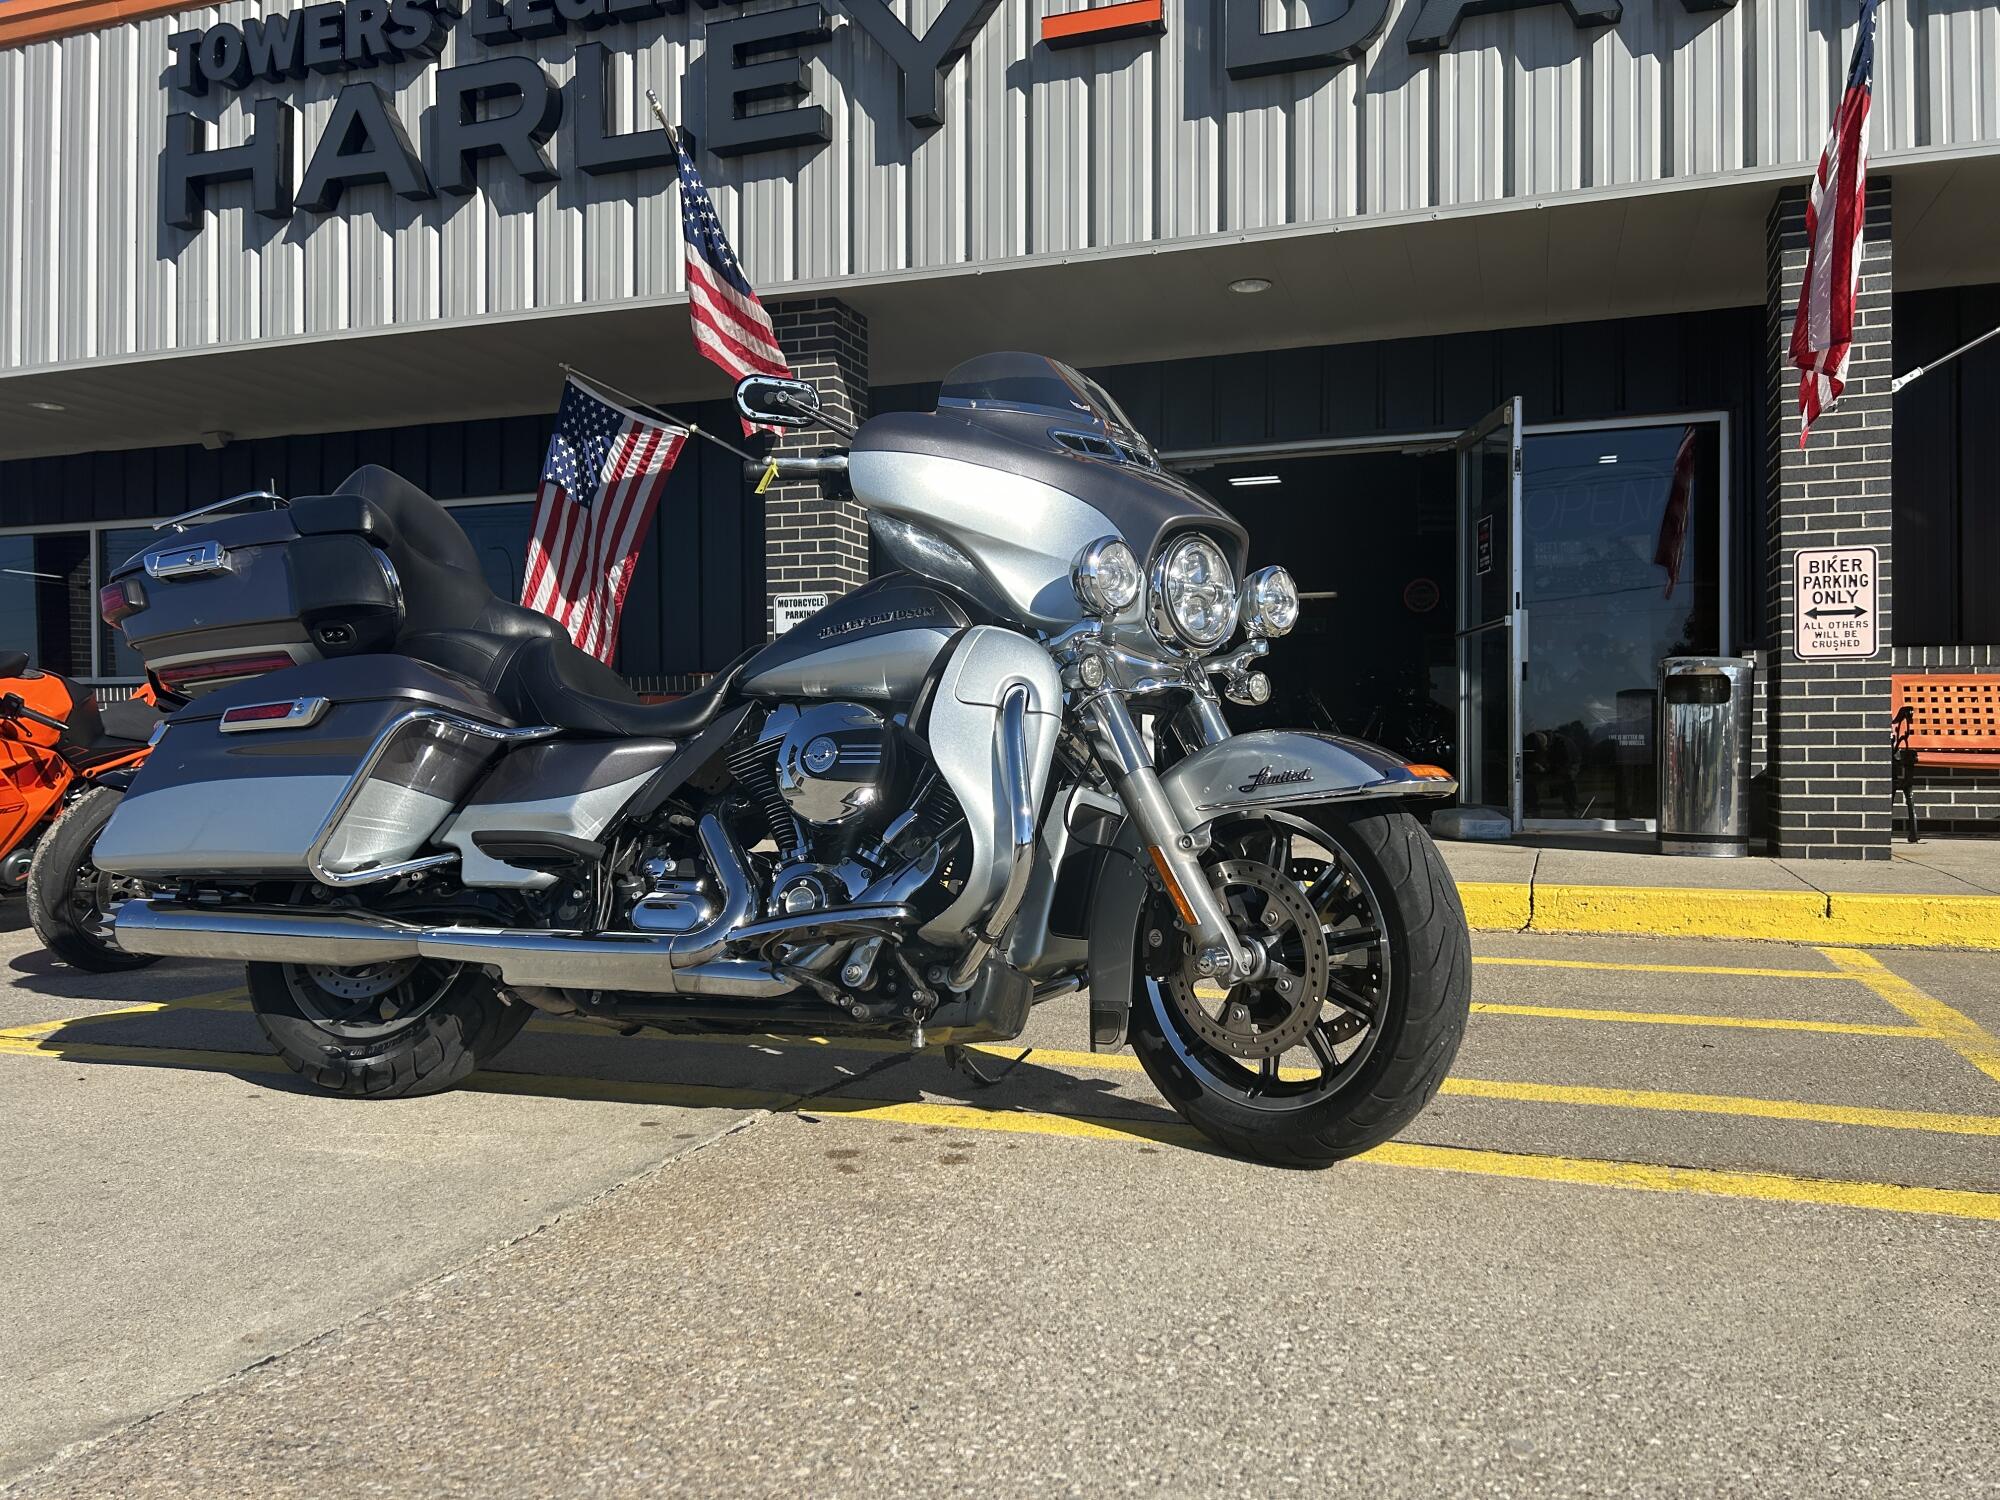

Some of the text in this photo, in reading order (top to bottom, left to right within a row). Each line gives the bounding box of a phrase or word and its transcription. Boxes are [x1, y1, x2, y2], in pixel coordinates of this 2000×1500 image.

[1809, 558, 1863, 574] BIKER
[1803, 574, 1869, 589] PARKING
[777, 598, 825, 608] MOTORCYCLE
[1812, 590, 1859, 604] ONLY
[1803, 620, 1869, 630] ALL OTHERS
[1814, 630, 1858, 638] WILL BE
[1812, 639, 1860, 649] CRUSHED
[1238, 764, 1315, 792] Limited
